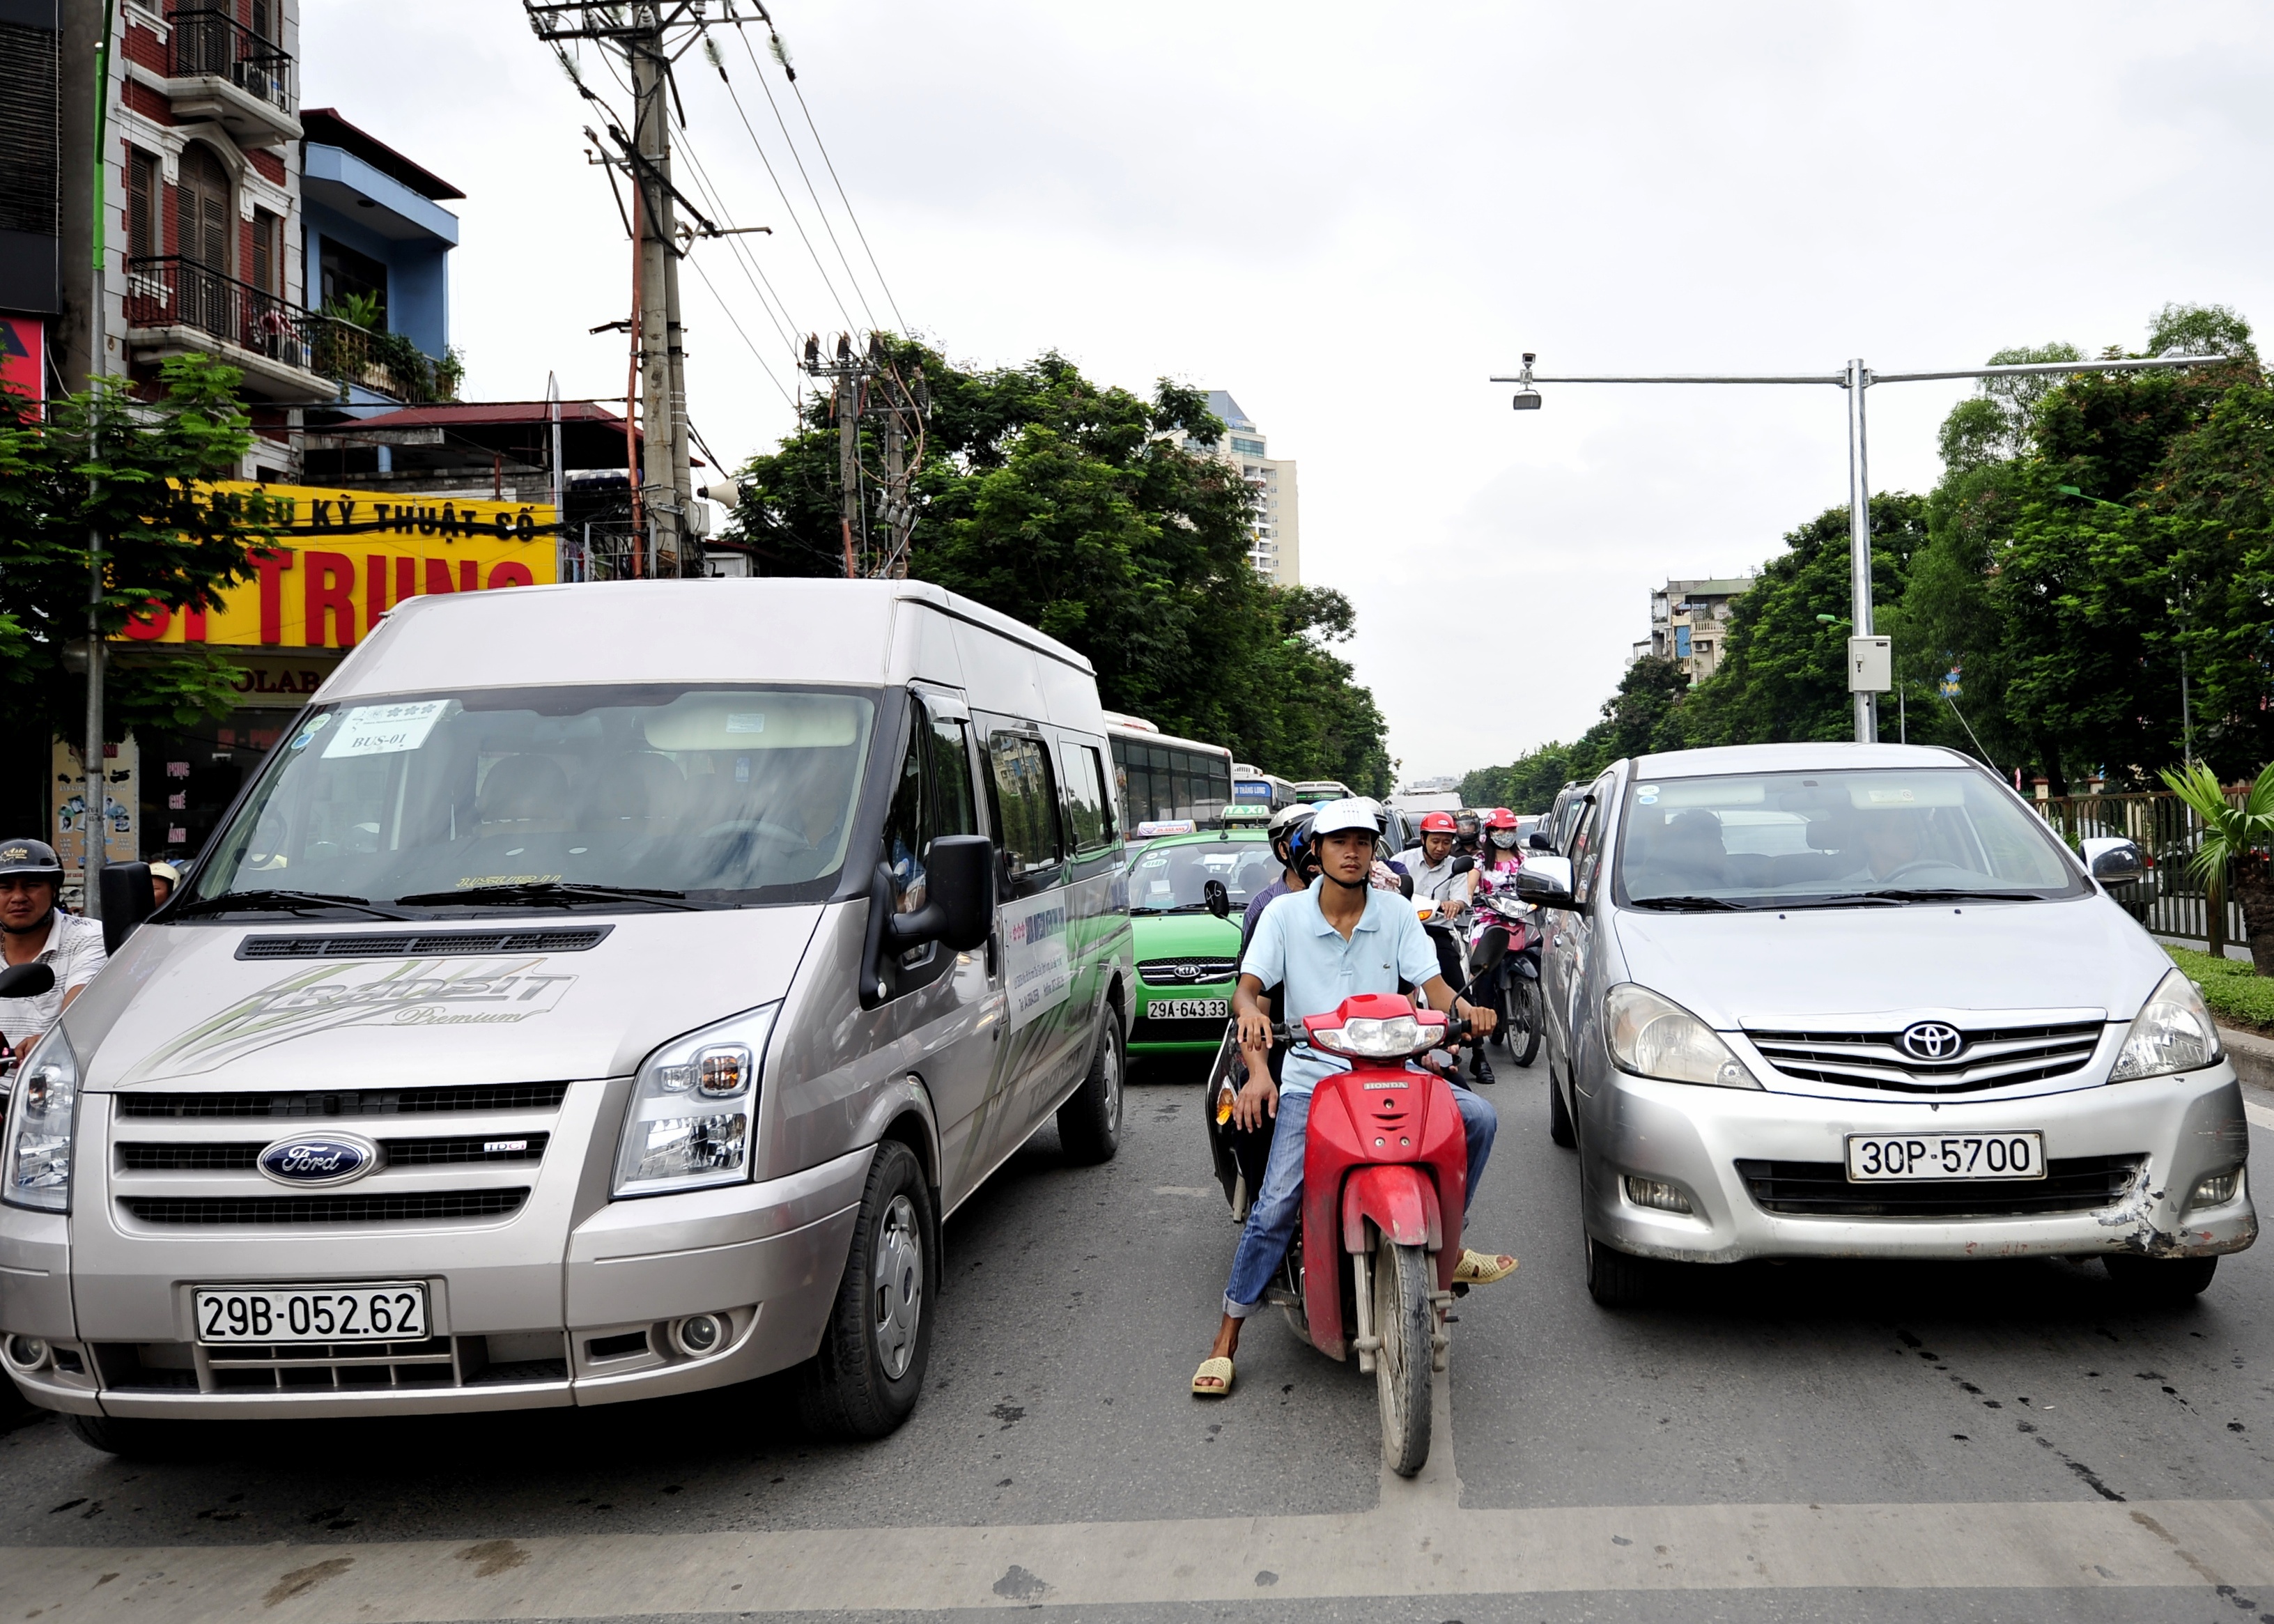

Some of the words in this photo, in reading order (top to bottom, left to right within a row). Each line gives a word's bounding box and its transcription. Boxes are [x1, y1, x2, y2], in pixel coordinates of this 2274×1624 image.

[373, 502, 477, 543] THUẬT
[495, 505, 535, 542] SỐ
[247, 547, 534, 647] TRU
[351, 733, 407, 748] BUS-01
[167, 762, 190, 780] PHỤC
[1205, 883, 1222, 906] 46
[1178, 967, 1197, 975] KIA
[394, 1006, 522, 1025] Premium
[1150, 1001, 1226, 1018] 29A-643.33
[281, 1145, 341, 1173] Ford
[1862, 1138, 2030, 1175] 30P-5700
[203, 1293, 419, 1336] 29B-052.62
